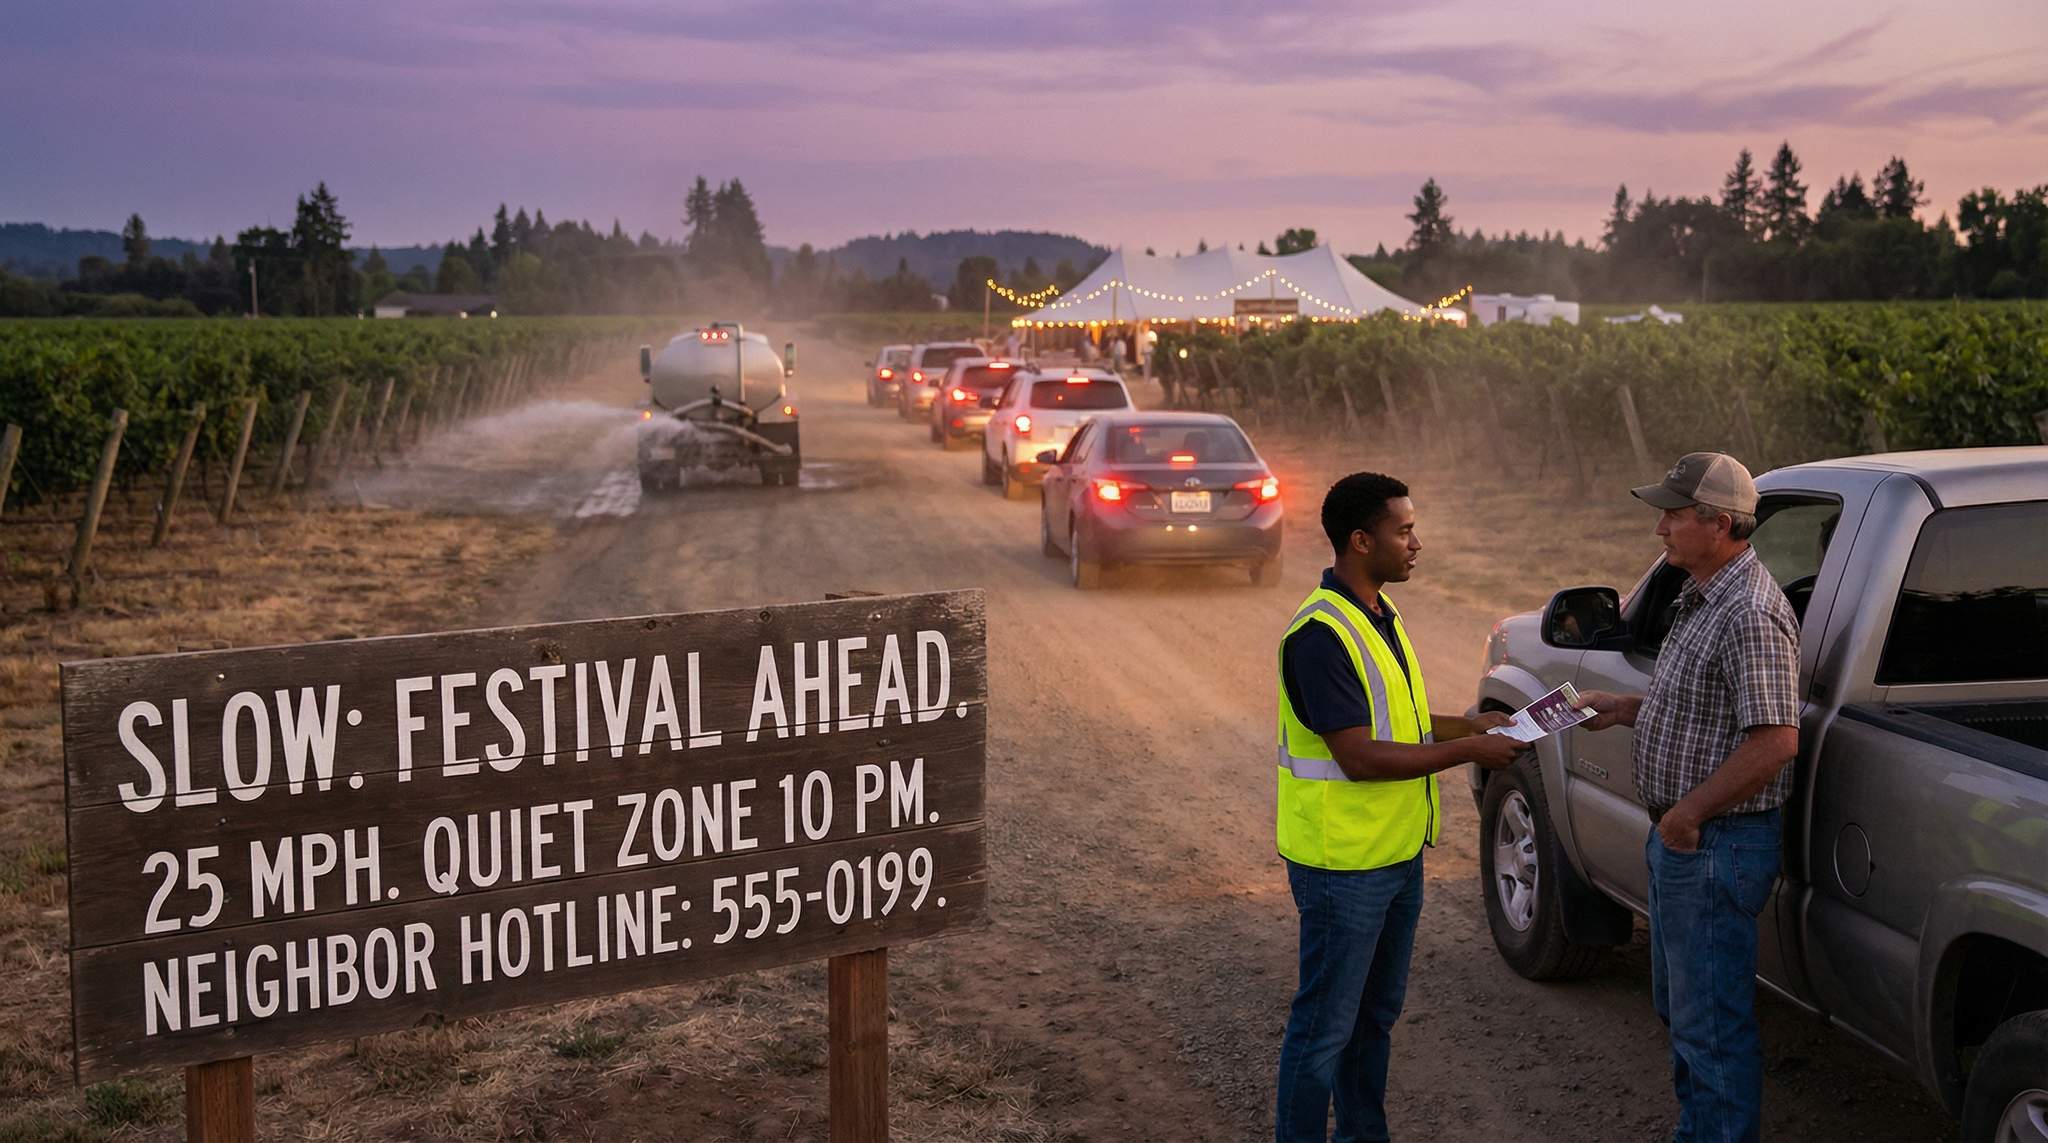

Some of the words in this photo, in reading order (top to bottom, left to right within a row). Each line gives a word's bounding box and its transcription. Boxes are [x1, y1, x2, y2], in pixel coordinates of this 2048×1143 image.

[117, 684, 364, 813] SLOW:
[395, 651, 723, 783] FESTIVAL
[745, 629, 968, 743] AHEAD.
[141, 845, 224, 935] 25
[250, 826, 400, 919] MPH.
[423, 798, 594, 896] QUIET
[616, 778, 759, 868] ZONE
[778, 769, 833, 844] 10
[855, 757, 940, 834] PM.
[143, 922, 438, 1036] NEIGHBOR
[460, 885, 692, 985] HOTLINE:
[712, 847, 947, 944] 555-0199.
